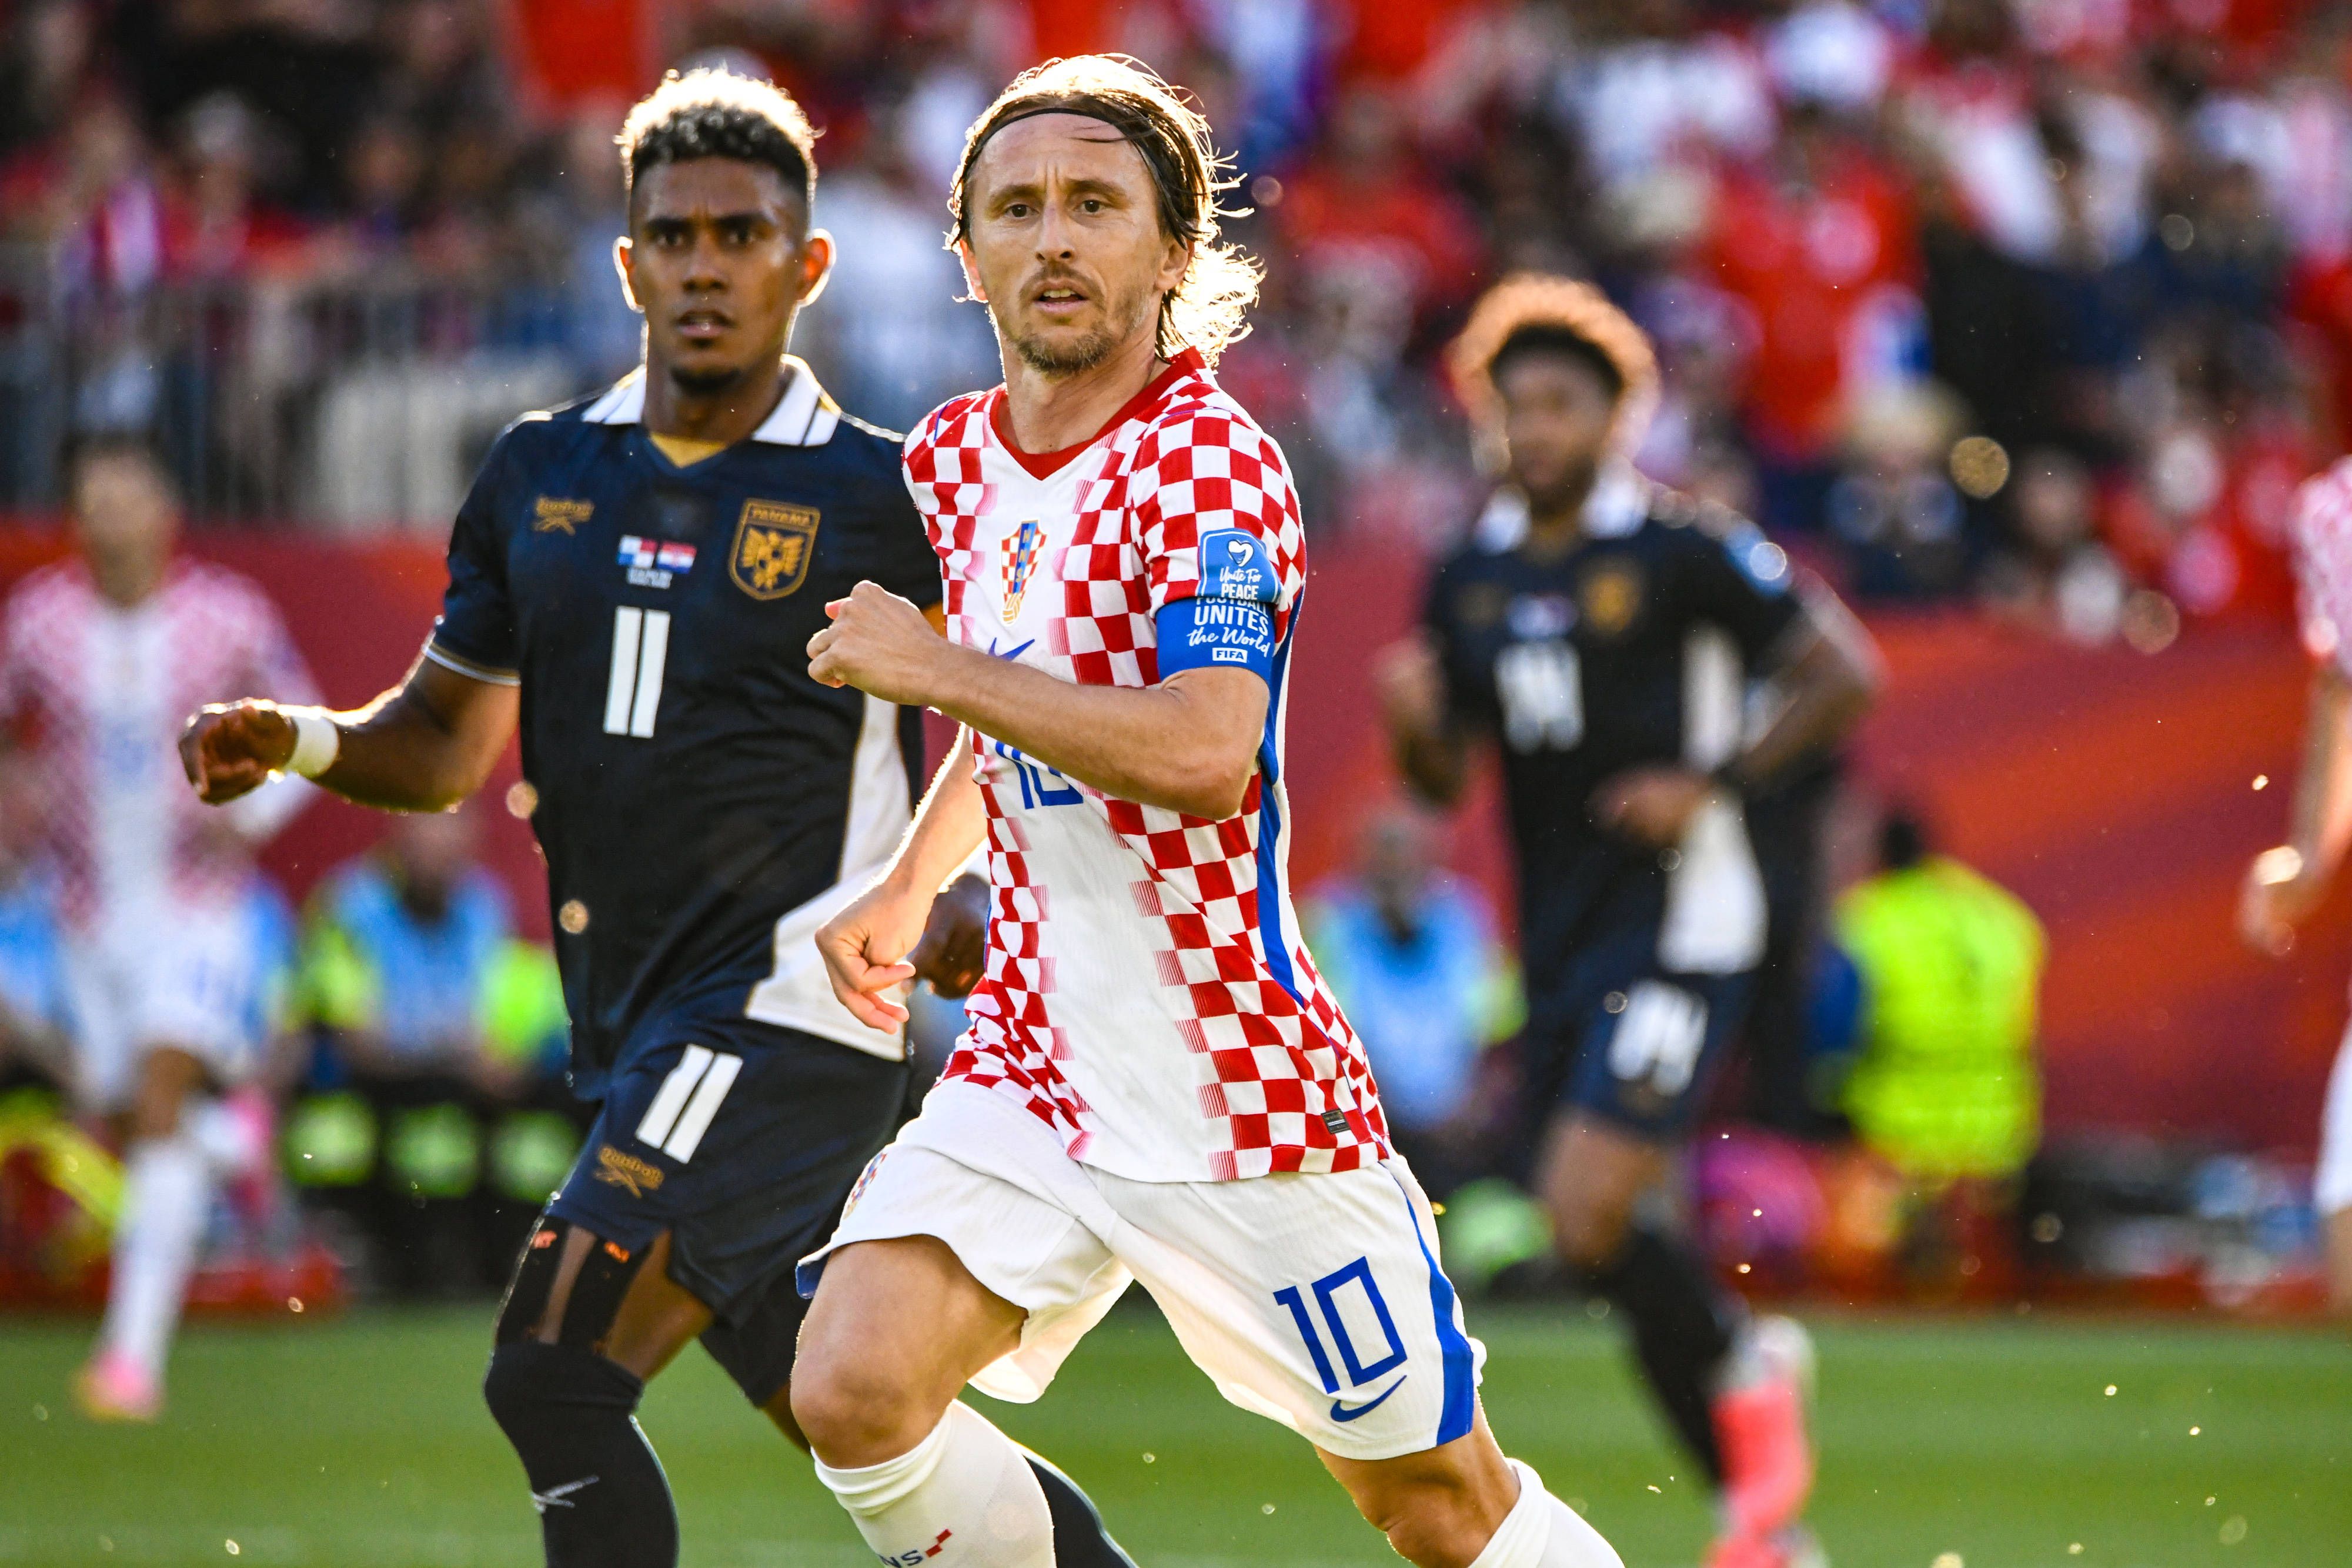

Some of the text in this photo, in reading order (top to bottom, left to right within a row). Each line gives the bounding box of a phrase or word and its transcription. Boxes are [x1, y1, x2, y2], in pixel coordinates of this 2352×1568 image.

[1220, 566, 1262, 584] Unite For
[1221, 583, 1259, 600] PEACE
[1194, 604, 1268, 636] UNITES
[1187, 626, 1271, 657] the World
[1216, 650, 1244, 660] FIFA
[603, 606, 670, 738] 11
[634, 1044, 743, 1165] 11
[1273, 1256, 1407, 1394] 10
